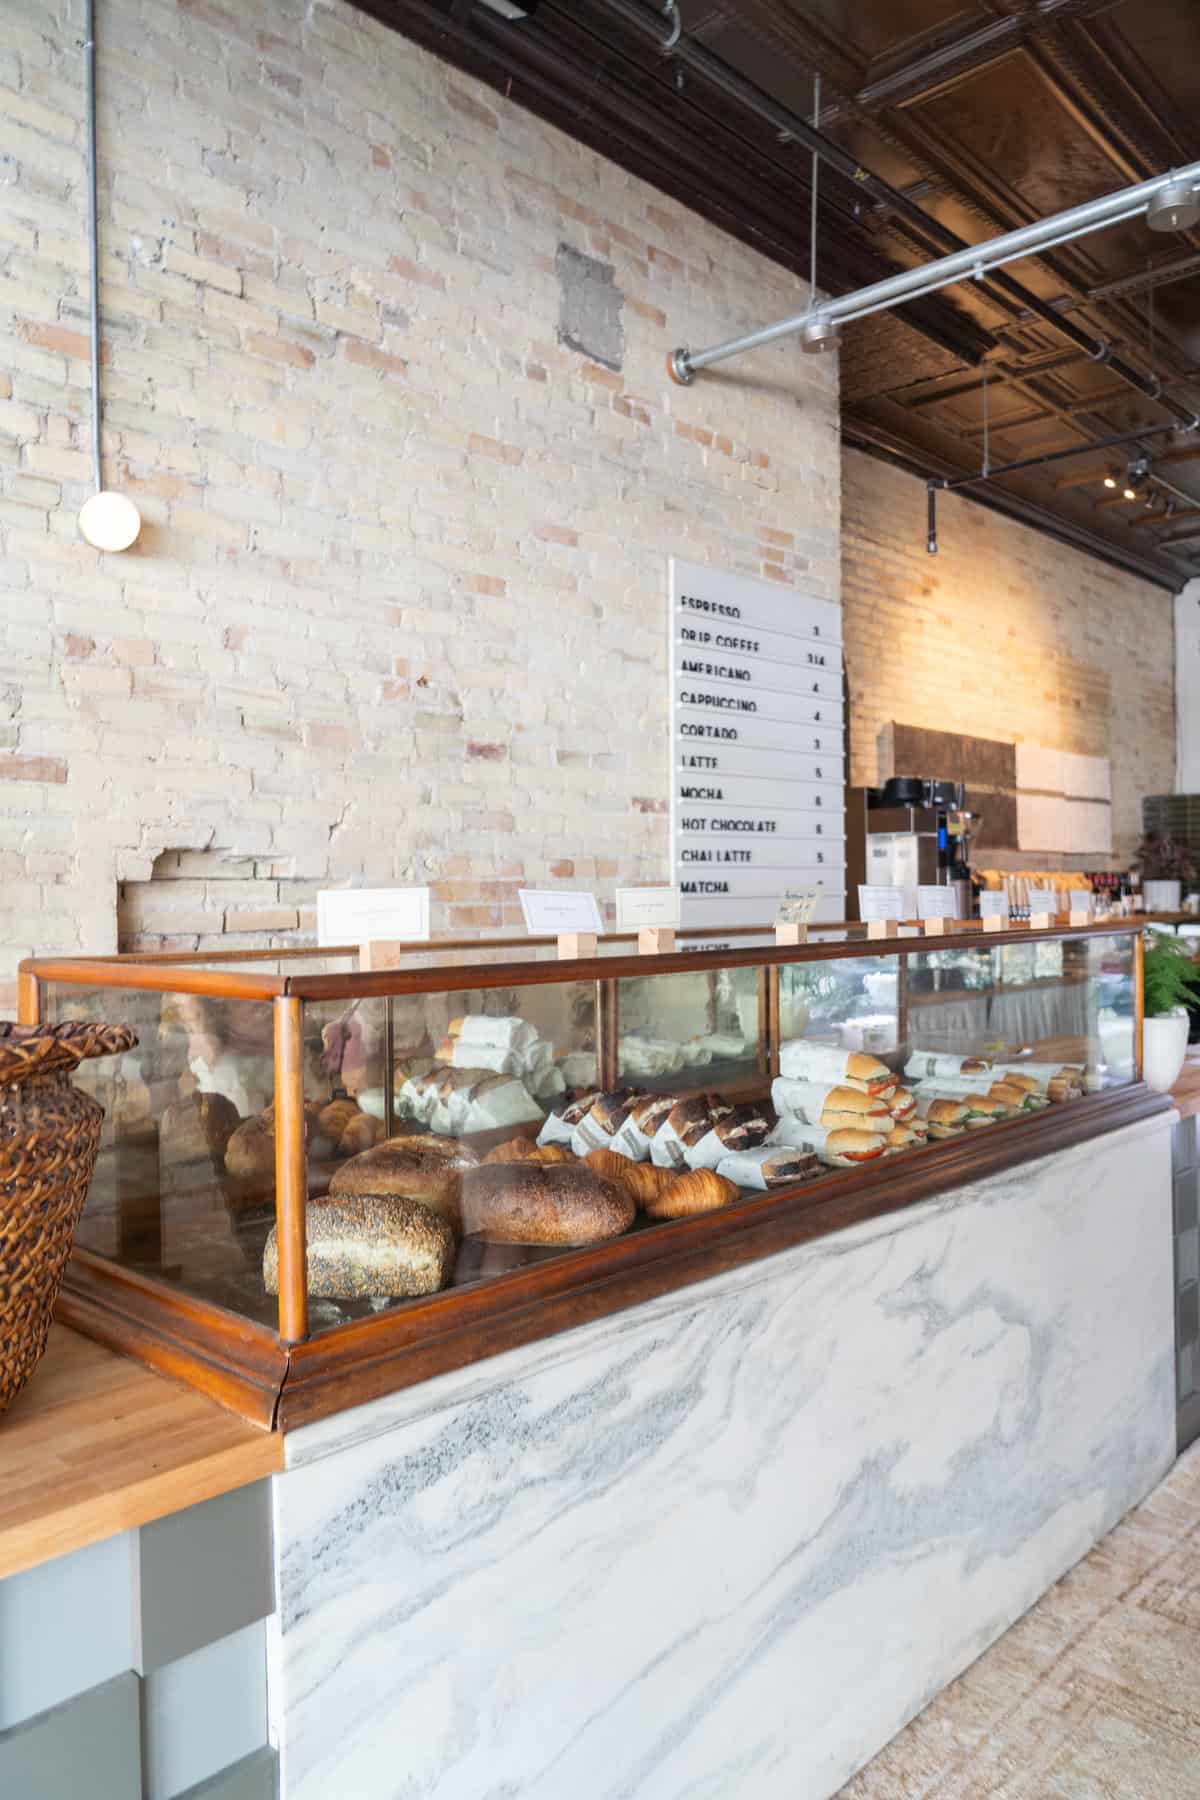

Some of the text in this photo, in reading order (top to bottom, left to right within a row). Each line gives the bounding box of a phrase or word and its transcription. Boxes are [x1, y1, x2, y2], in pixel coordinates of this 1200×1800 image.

[681, 596, 740, 618] ESPRESSO
[681, 628, 711, 643] DRIP
[715, 635, 760, 652] COFFEE
[681, 660, 751, 681] AMERICANO
[680, 692, 757, 712] CAPPUCCINO
[680, 723, 738, 740] CORTADO
[681, 755, 718, 768] LATTE
[681, 787, 724, 800] MOCHA
[682, 818, 707, 831] HOT
[711, 819, 777, 833] CHOCOLATE
[681, 850, 712, 863] CHAI
[717, 850, 752, 863] LATTE
[680, 881, 729, 894] MATCHA
